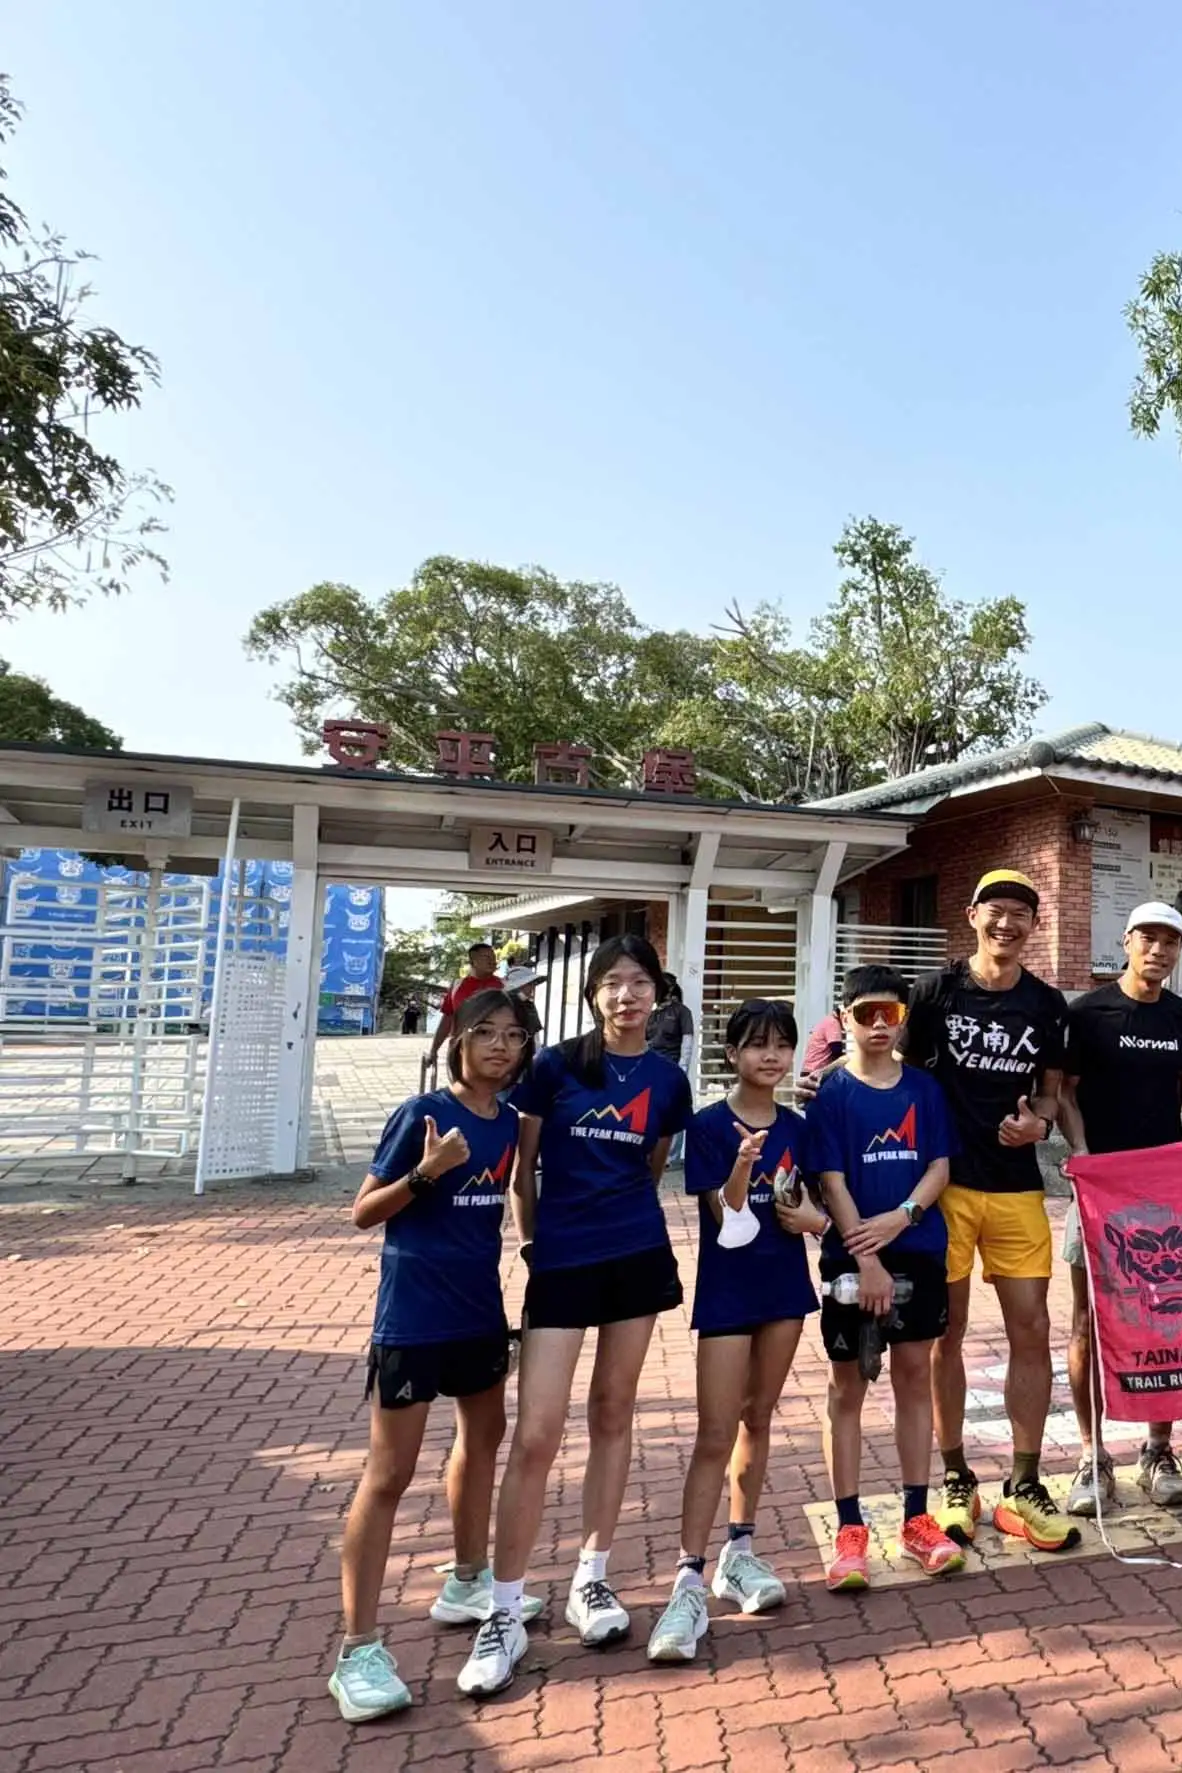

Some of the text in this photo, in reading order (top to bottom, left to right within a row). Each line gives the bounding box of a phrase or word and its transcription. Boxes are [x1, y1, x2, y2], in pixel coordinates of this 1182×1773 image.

[323, 718, 696, 795] 安平古堡
[107, 788, 170, 815] 出口
[119, 818, 153, 829] EXIT
[487, 832, 537, 854] 入口
[485, 857, 536, 868] ENTRANCE
[944, 1014, 1040, 1056] 野南人
[948, 1042, 1036, 1074] YENANer
[570, 1126, 587, 1137] THE
[588, 1127, 613, 1140] PEAK
[453, 1195, 470, 1206] THE
[1127, 1375, 1166, 1390] TRAIL
